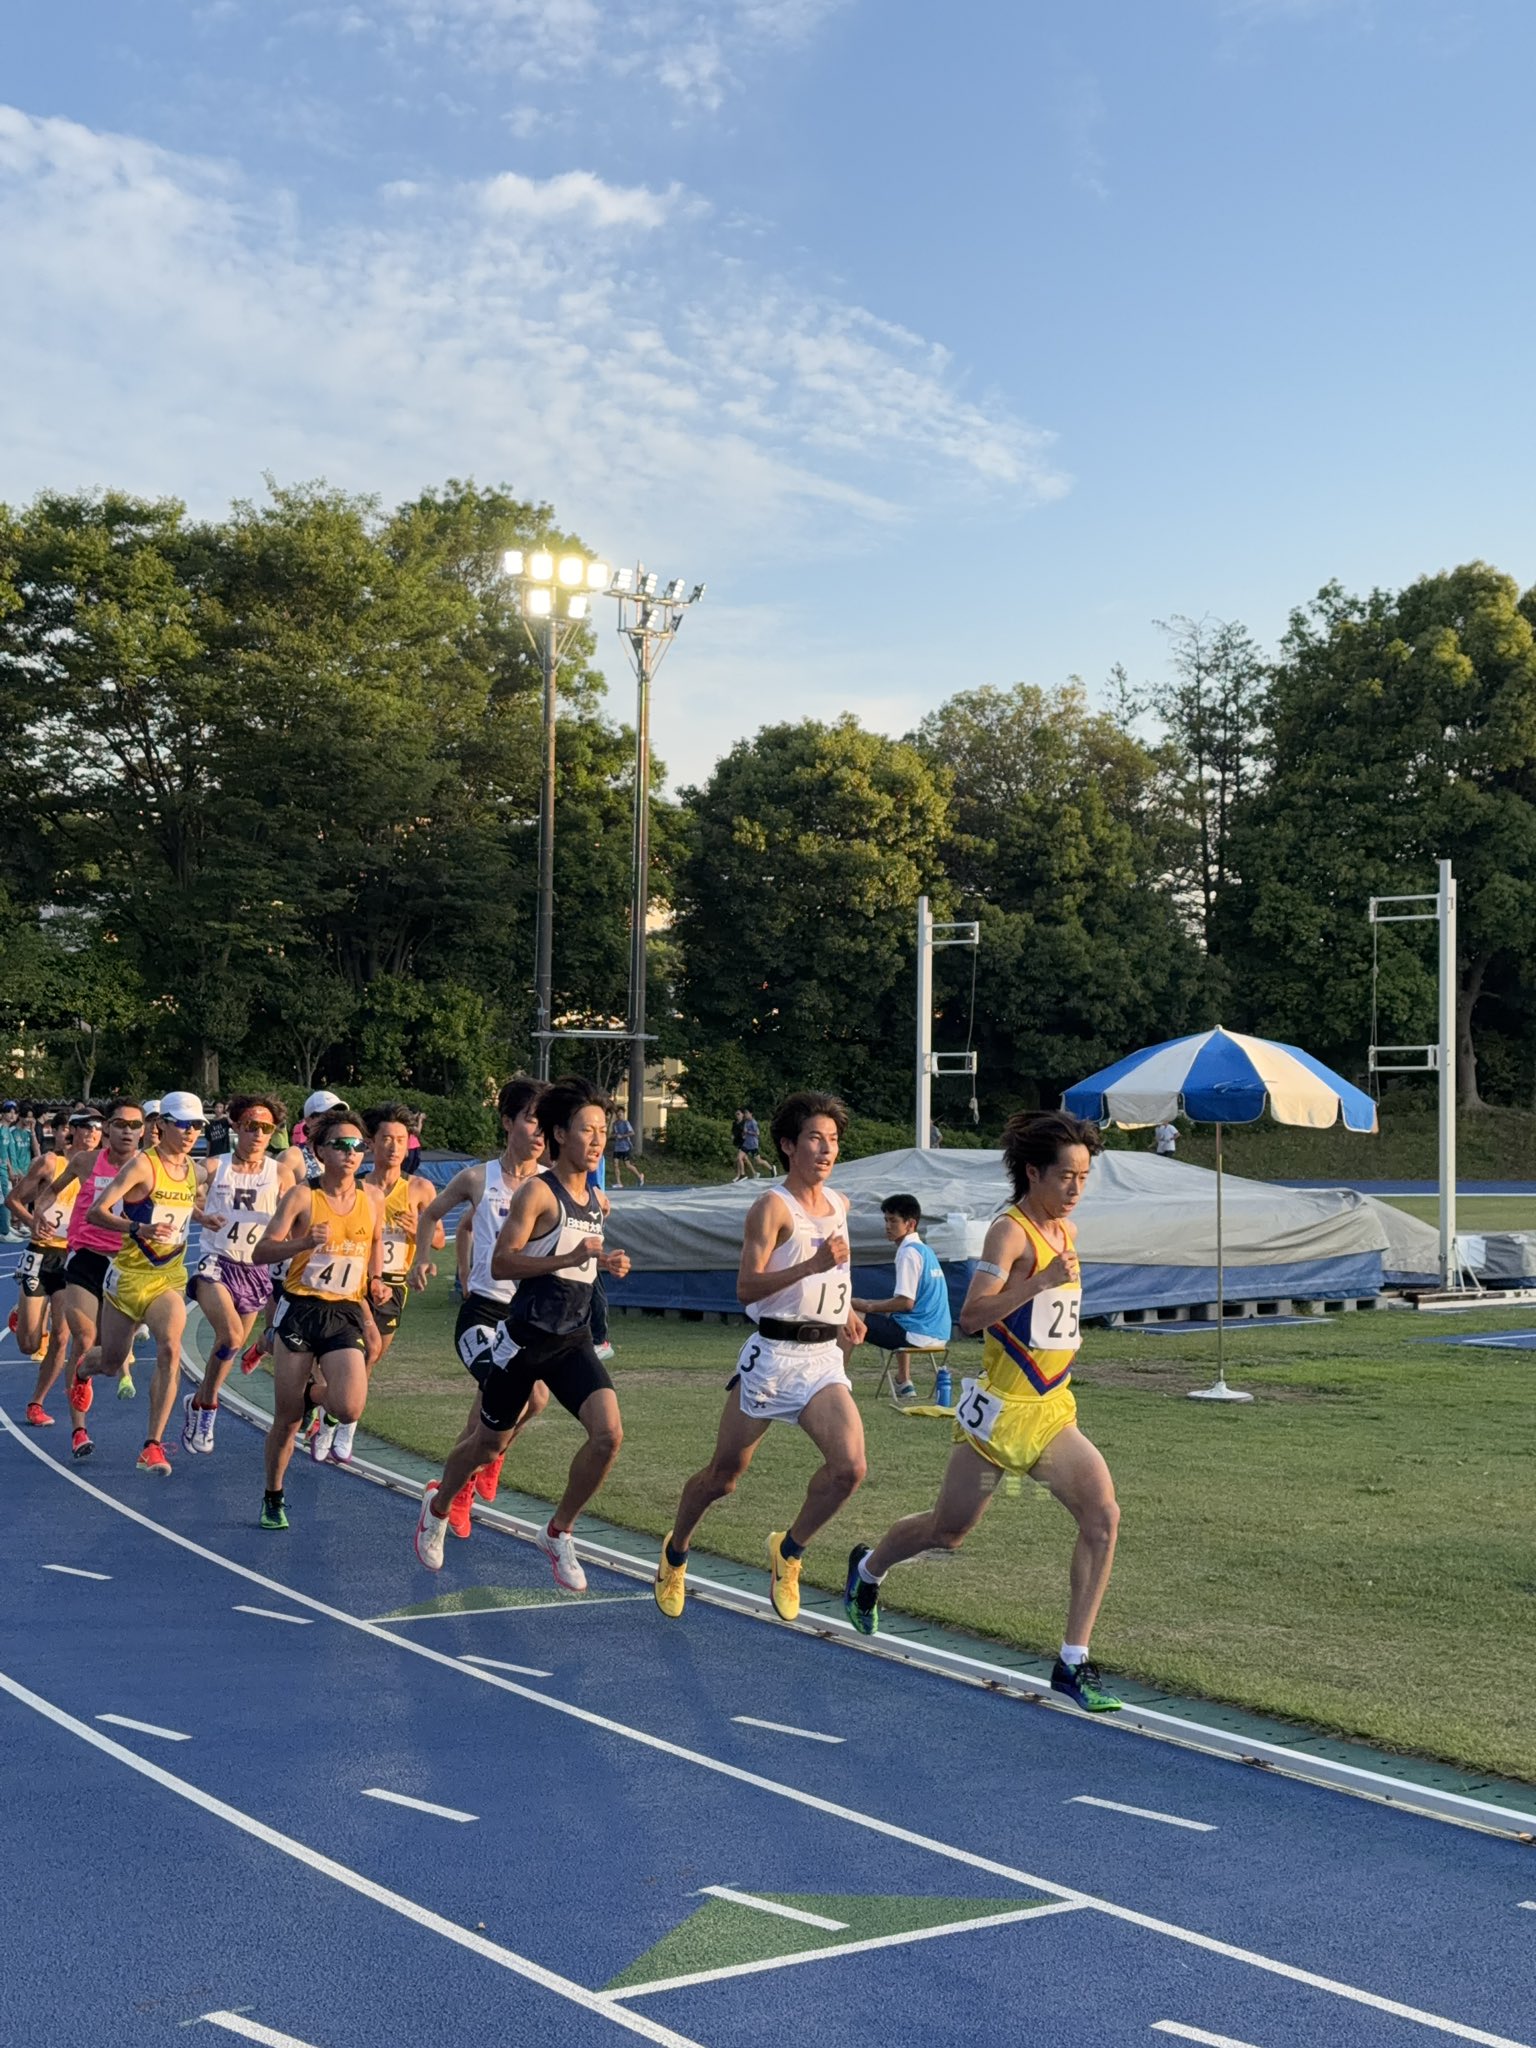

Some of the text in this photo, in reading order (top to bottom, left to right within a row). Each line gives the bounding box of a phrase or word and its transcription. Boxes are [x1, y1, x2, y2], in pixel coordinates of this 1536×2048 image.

[233, 1187, 257, 1211] R
[227, 1221, 257, 1244] 46
[319, 1262, 352, 1288] 41
[816, 1282, 848, 1315] 13
[1047, 1300, 1079, 1338] 25
[740, 1344, 761, 1373] 3
[958, 1385, 990, 1429] 25
